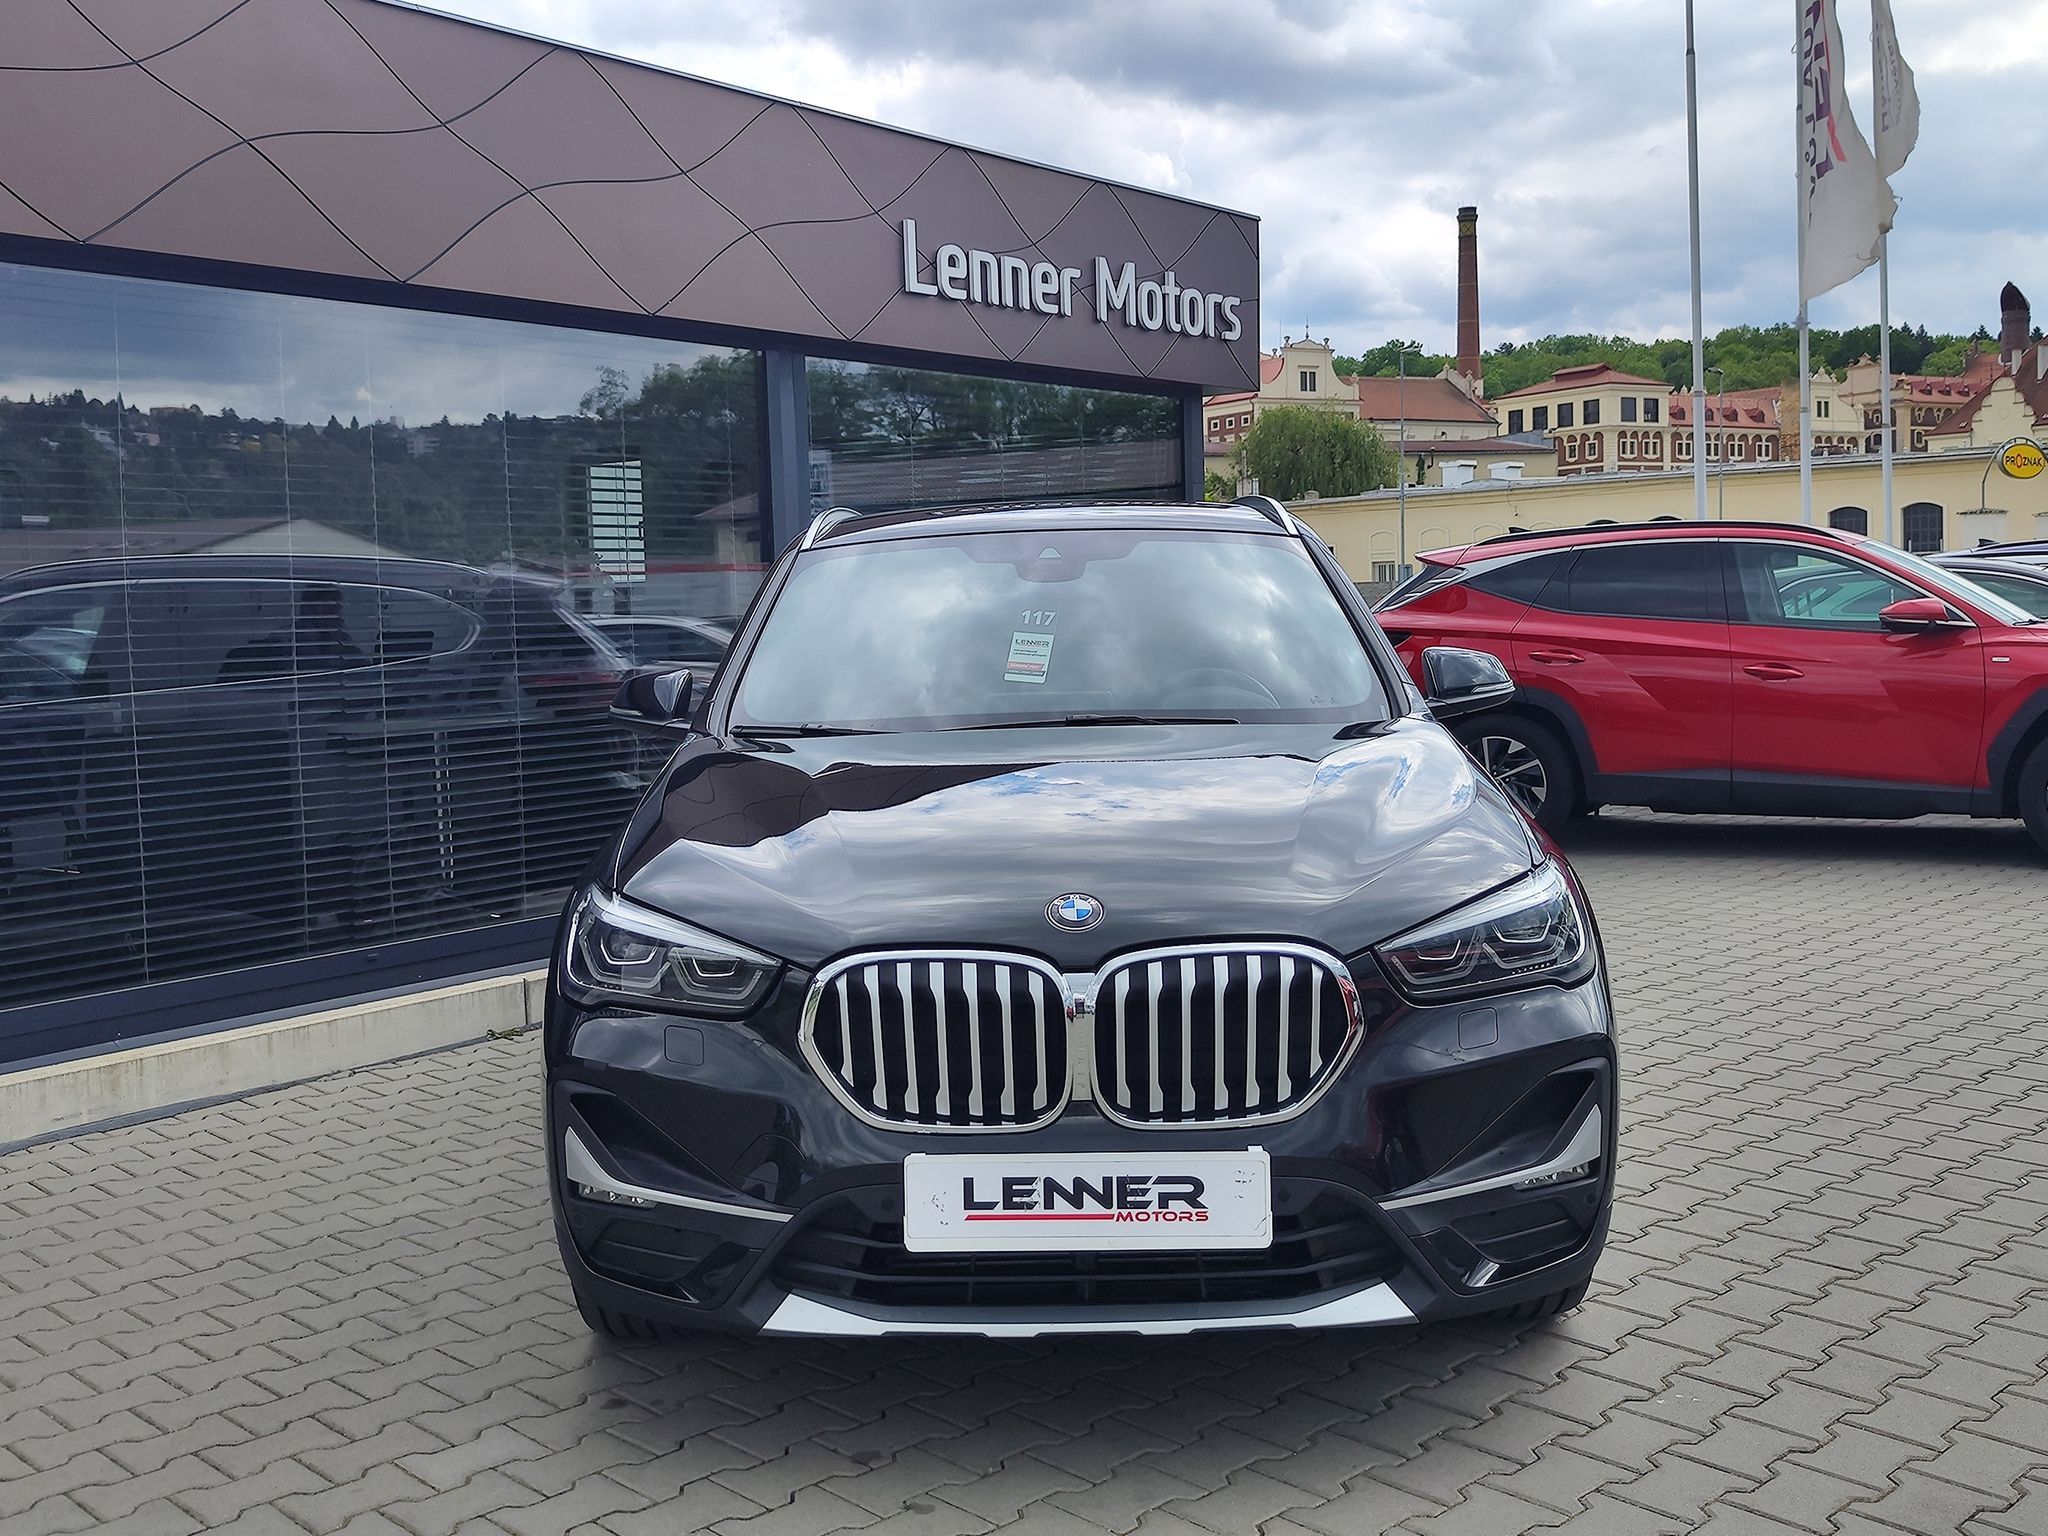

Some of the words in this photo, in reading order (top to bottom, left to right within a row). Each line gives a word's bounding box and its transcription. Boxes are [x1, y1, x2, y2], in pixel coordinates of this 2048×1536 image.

[902, 218, 1081, 317] Lenner
[1094, 255, 1243, 341] Motors
[2005, 453, 2043, 469] PROZNAK
[1021, 610, 1057, 626] 117
[962, 1176, 1209, 1211] LENNER
[1115, 1211, 1210, 1223] MOTORS
